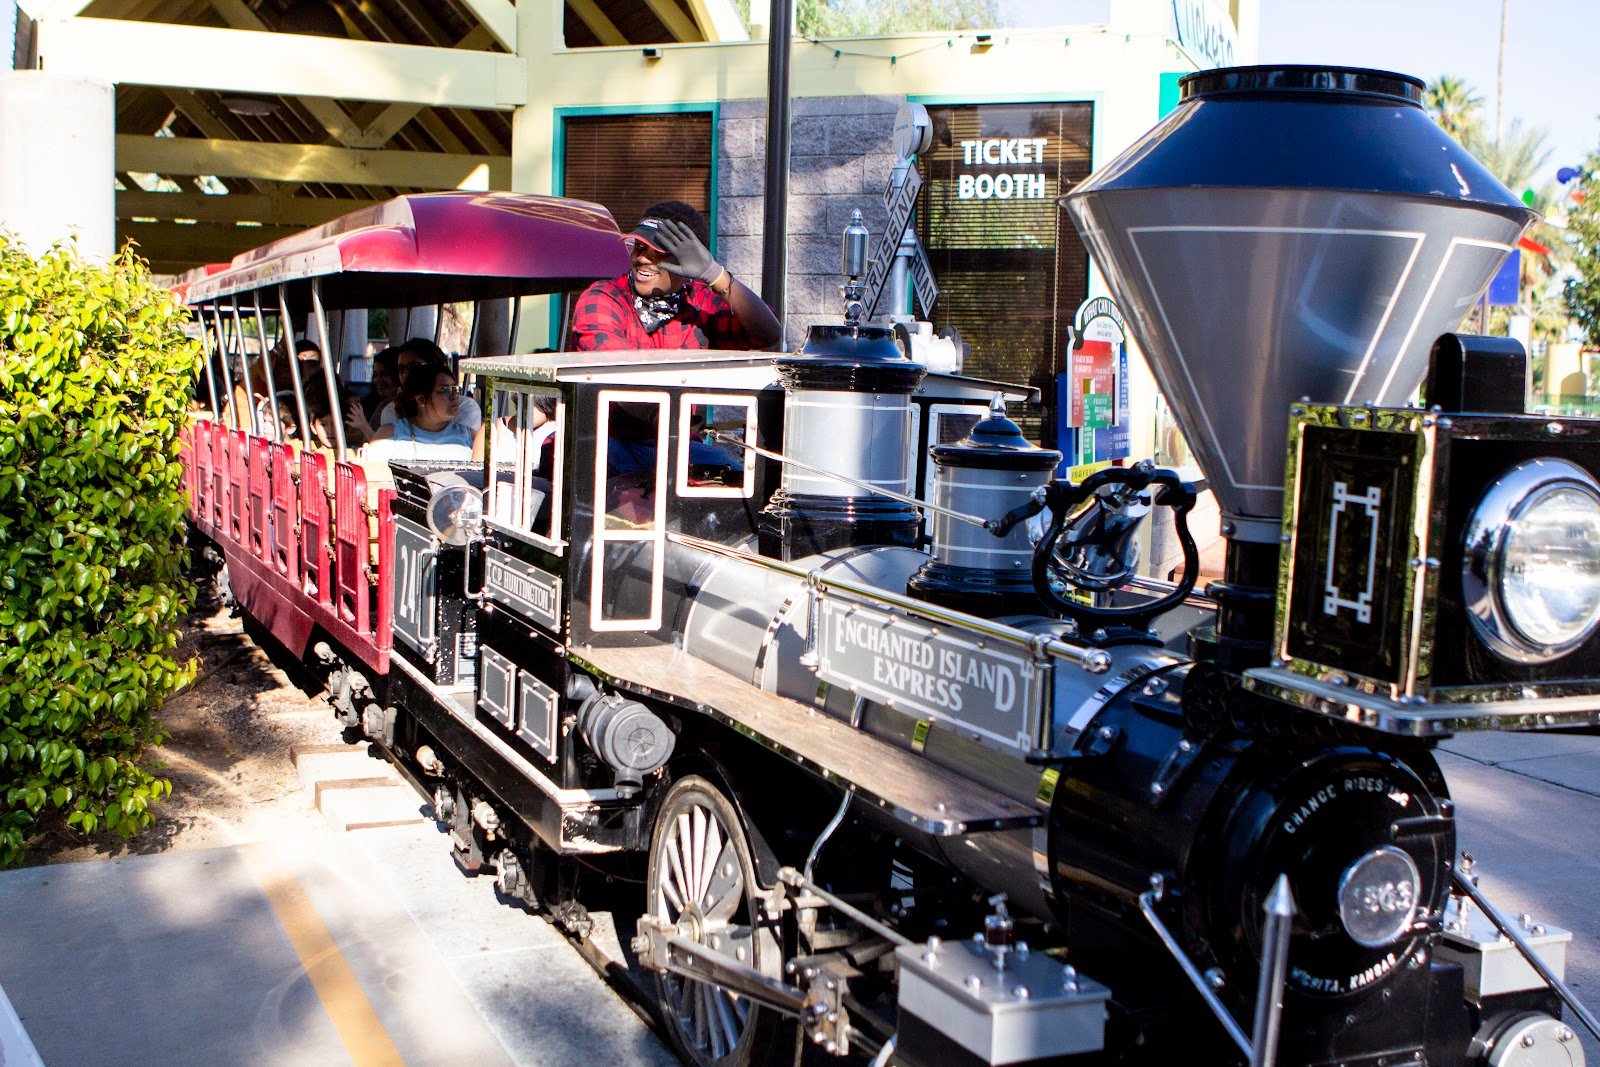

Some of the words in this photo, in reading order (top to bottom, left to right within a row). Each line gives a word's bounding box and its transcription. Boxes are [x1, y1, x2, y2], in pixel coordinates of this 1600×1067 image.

[961, 139, 1047, 165] TICKET
[958, 174, 1046, 199] BOOTH
[863, 178, 916, 311] CROSSING
[1098, 298, 1109, 314] CAN
[503, 572, 549, 611] HUNTINGTON
[834, 613, 935, 671] ENCHANTED
[938, 648, 1017, 712] ISLAND
[872, 656, 963, 712] EXPRESS
[1283, 784, 1337, 834] CHANCE
[1350, 952, 1396, 990] KANSAS
